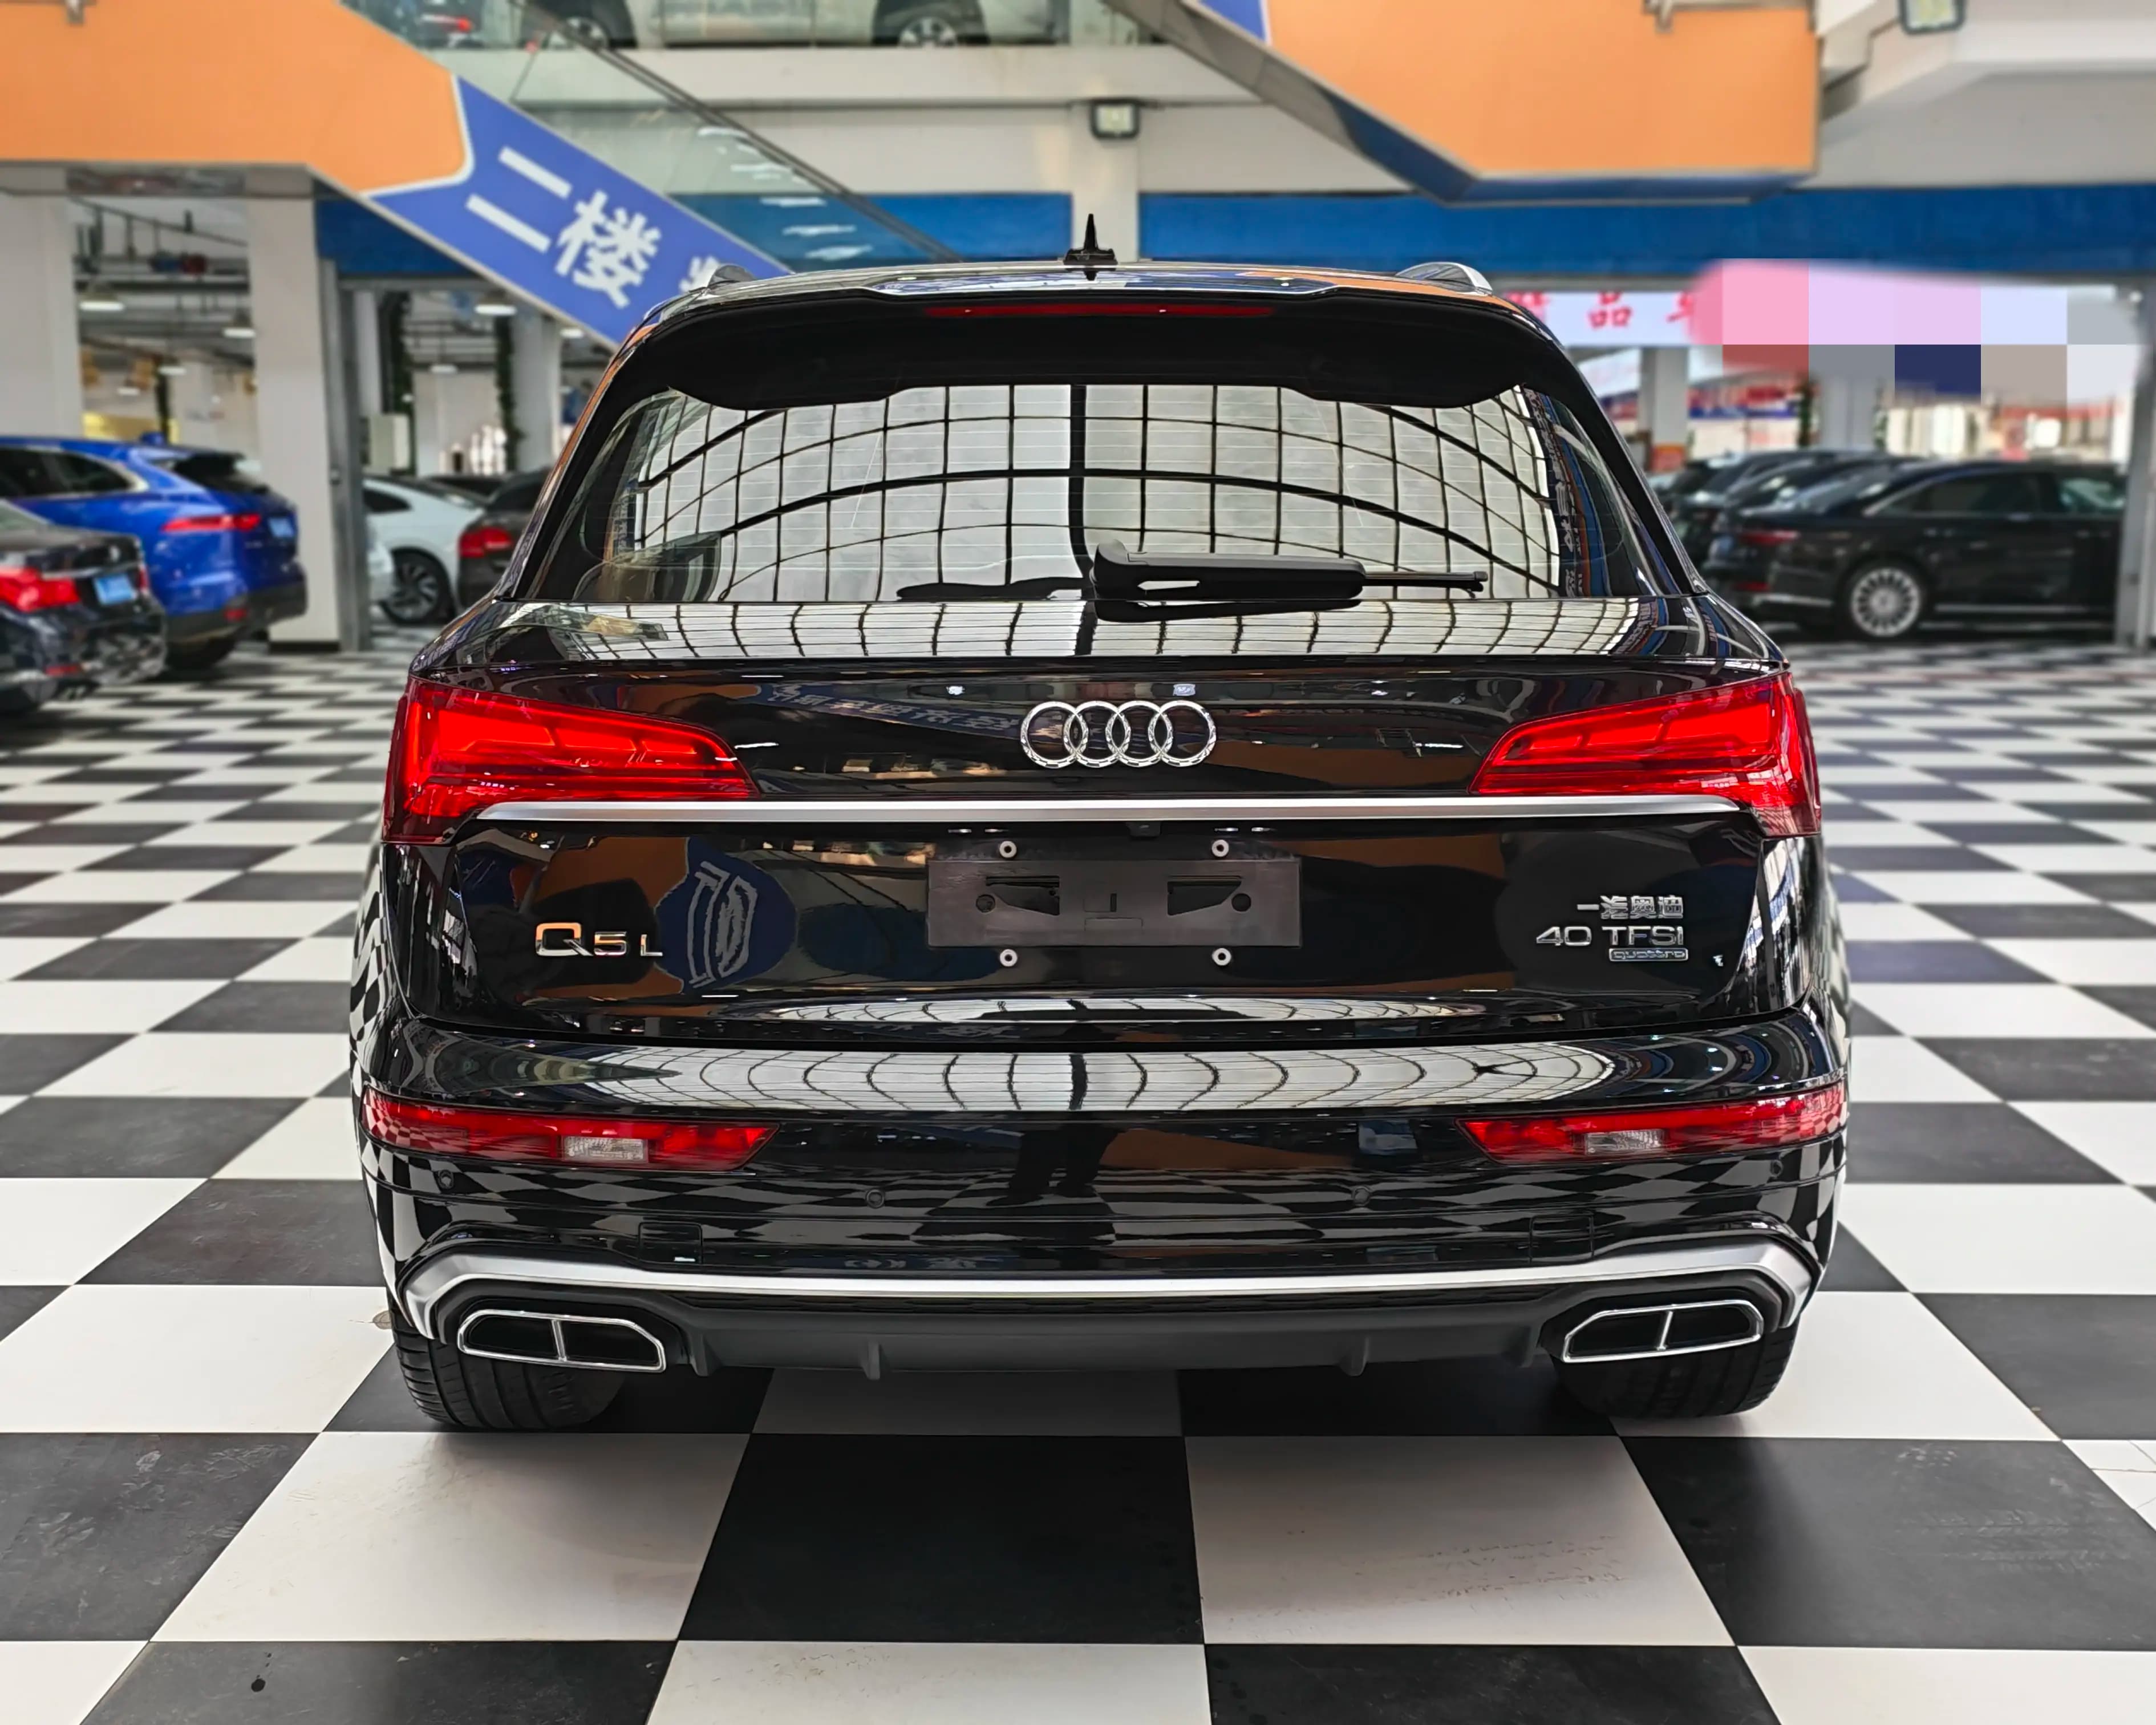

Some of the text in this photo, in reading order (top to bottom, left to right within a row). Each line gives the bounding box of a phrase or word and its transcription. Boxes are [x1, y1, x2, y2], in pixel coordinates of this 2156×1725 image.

[1536, 925, 1684, 946] 40 TFSI
[1611, 948, 1687, 961] quattro
